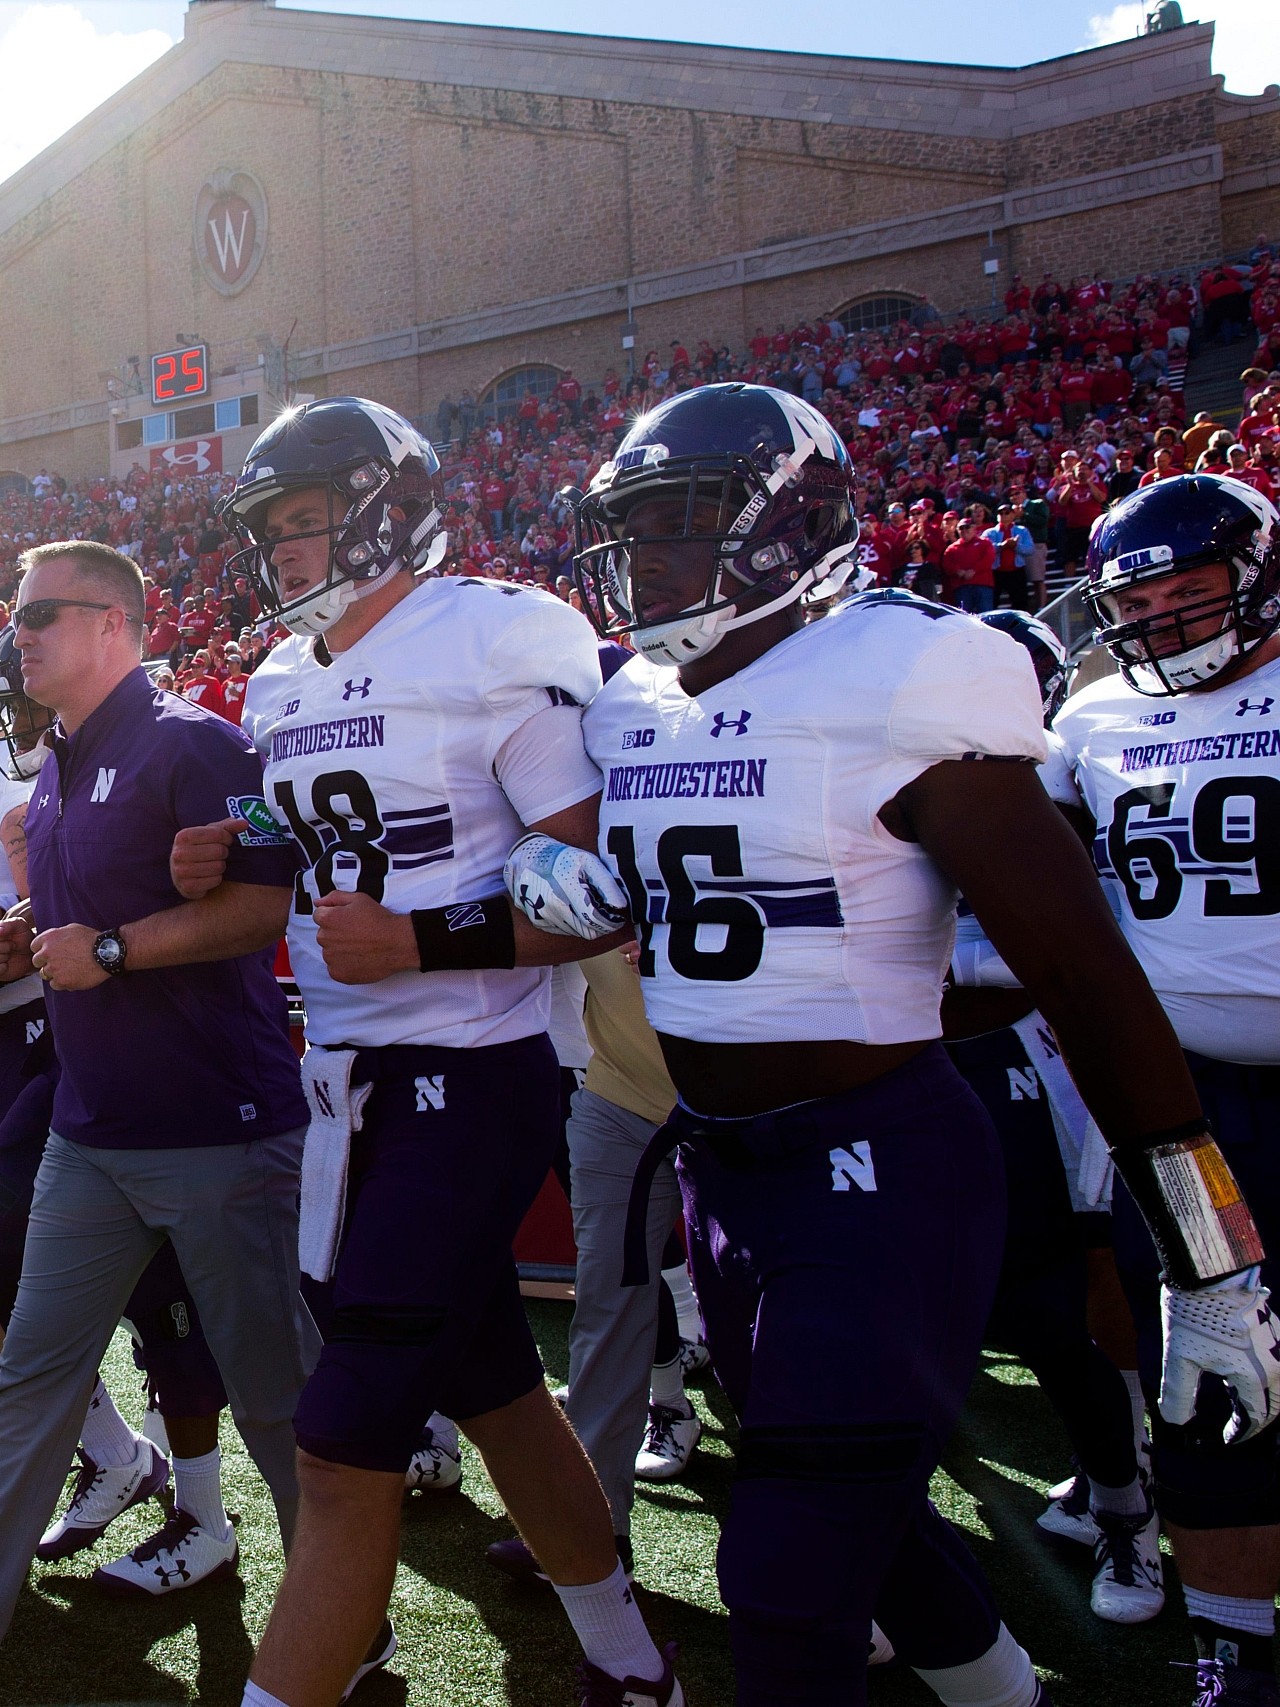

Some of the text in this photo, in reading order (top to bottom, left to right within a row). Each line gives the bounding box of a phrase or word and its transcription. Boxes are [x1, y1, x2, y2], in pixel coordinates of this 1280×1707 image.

[208, 208, 251, 274] W
[155, 351, 204, 398] 25
[272, 715, 385, 763] NORTHWESTERN
[90, 768, 117, 802] N
[607, 759, 767, 801] NORTHWESTERN
[273, 769, 386, 915] 18
[1107, 774, 1280, 921] 69
[445, 903, 485, 931] N
[606, 824, 767, 982] 16
[415, 1074, 445, 1111] N
[1006, 1066, 1040, 1100] N
[830, 1140, 878, 1192] N
